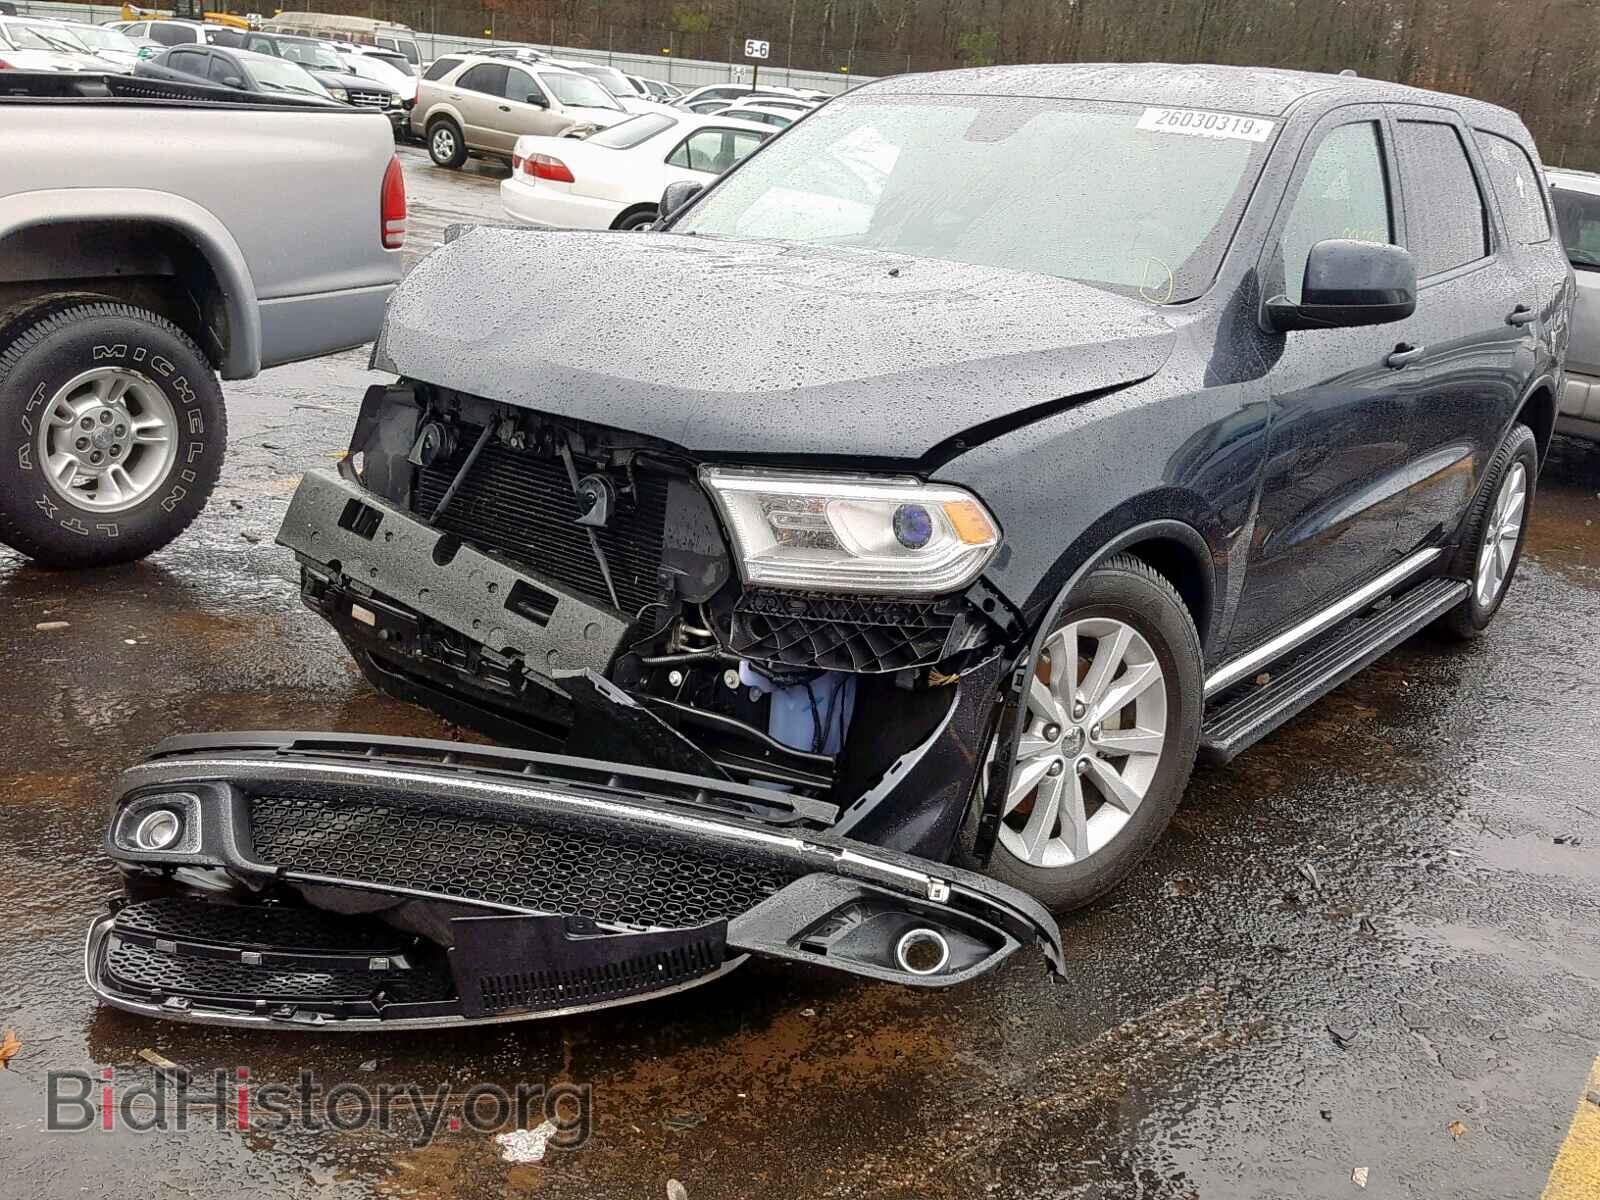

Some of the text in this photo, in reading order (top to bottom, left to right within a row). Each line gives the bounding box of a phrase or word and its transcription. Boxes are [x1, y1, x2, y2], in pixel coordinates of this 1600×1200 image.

[746, 41, 768, 57] 5-6
[18, 381, 119, 537] LTX A/T
[92, 344, 204, 512] MICHELIN
